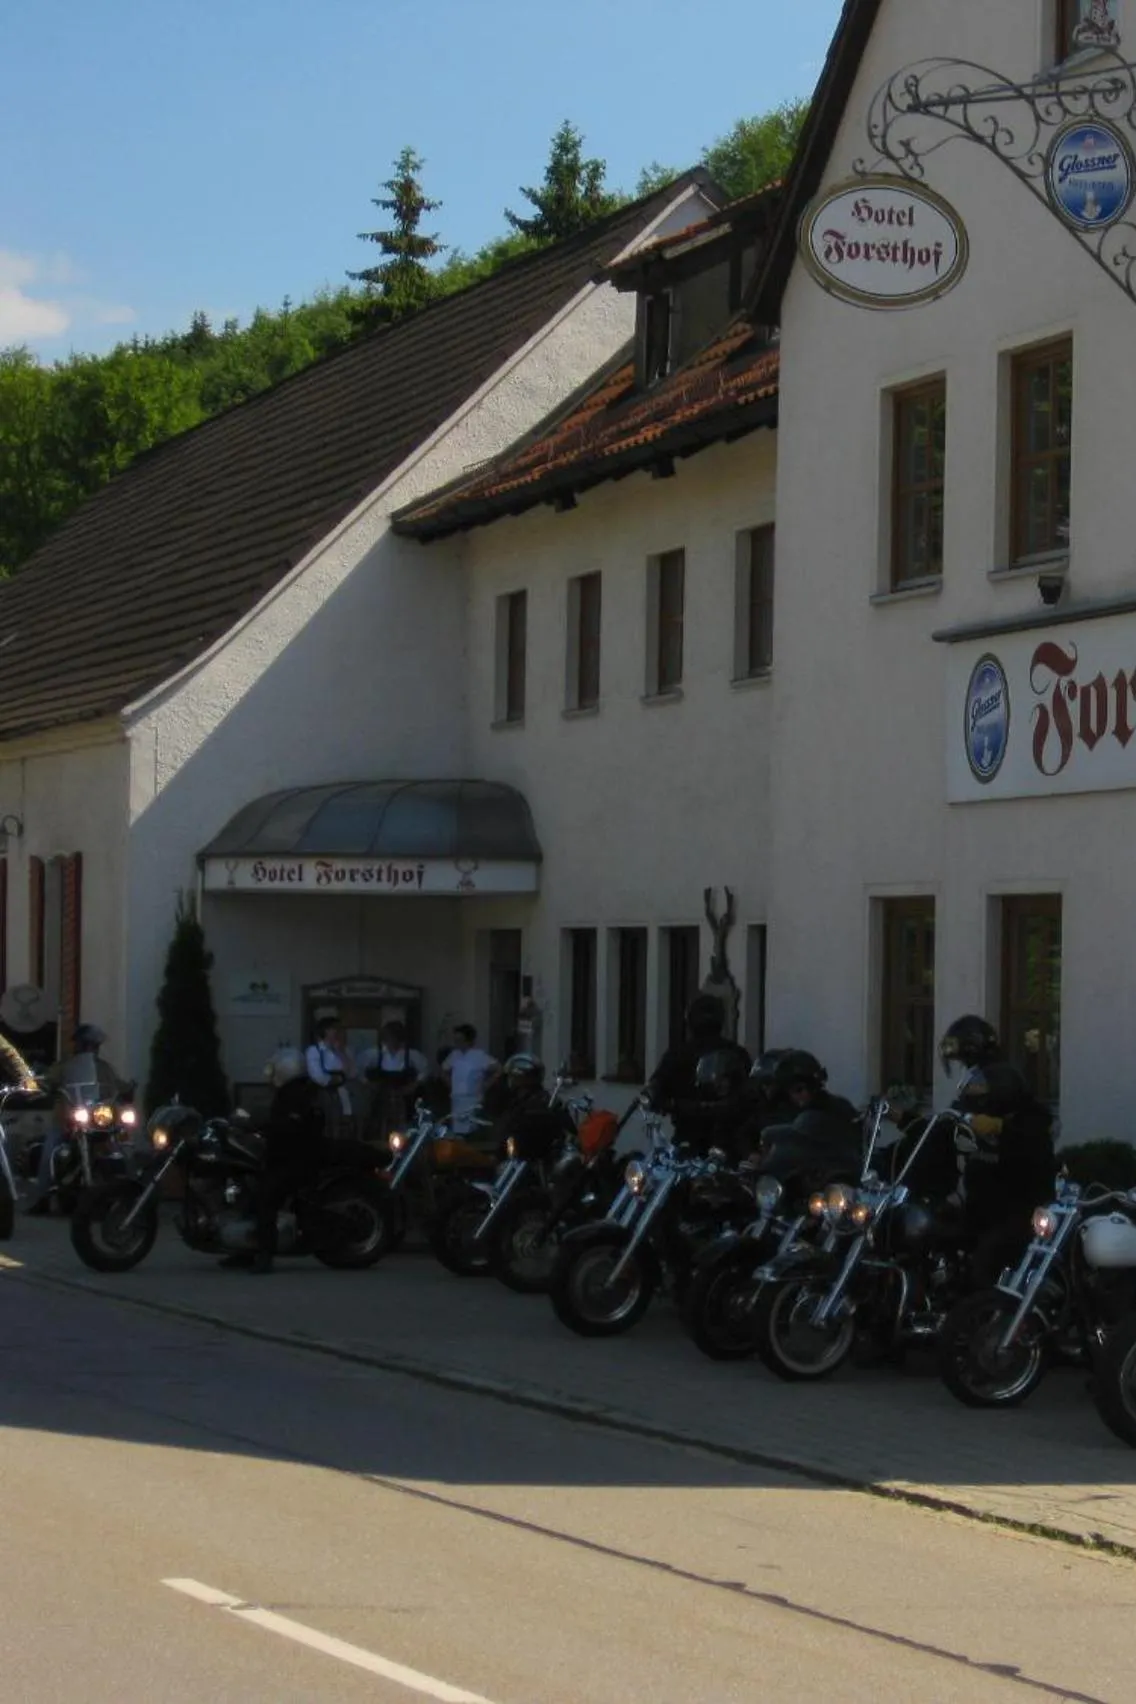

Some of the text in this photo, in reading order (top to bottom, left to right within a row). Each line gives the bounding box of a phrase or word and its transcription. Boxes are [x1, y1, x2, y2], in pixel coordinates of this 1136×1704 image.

[1058, 152, 1121, 182] Glossner
[851, 198, 915, 227] Hotel
[822, 229, 943, 275] Forsthof
[252, 860, 425, 890] Hotel Forsthof
